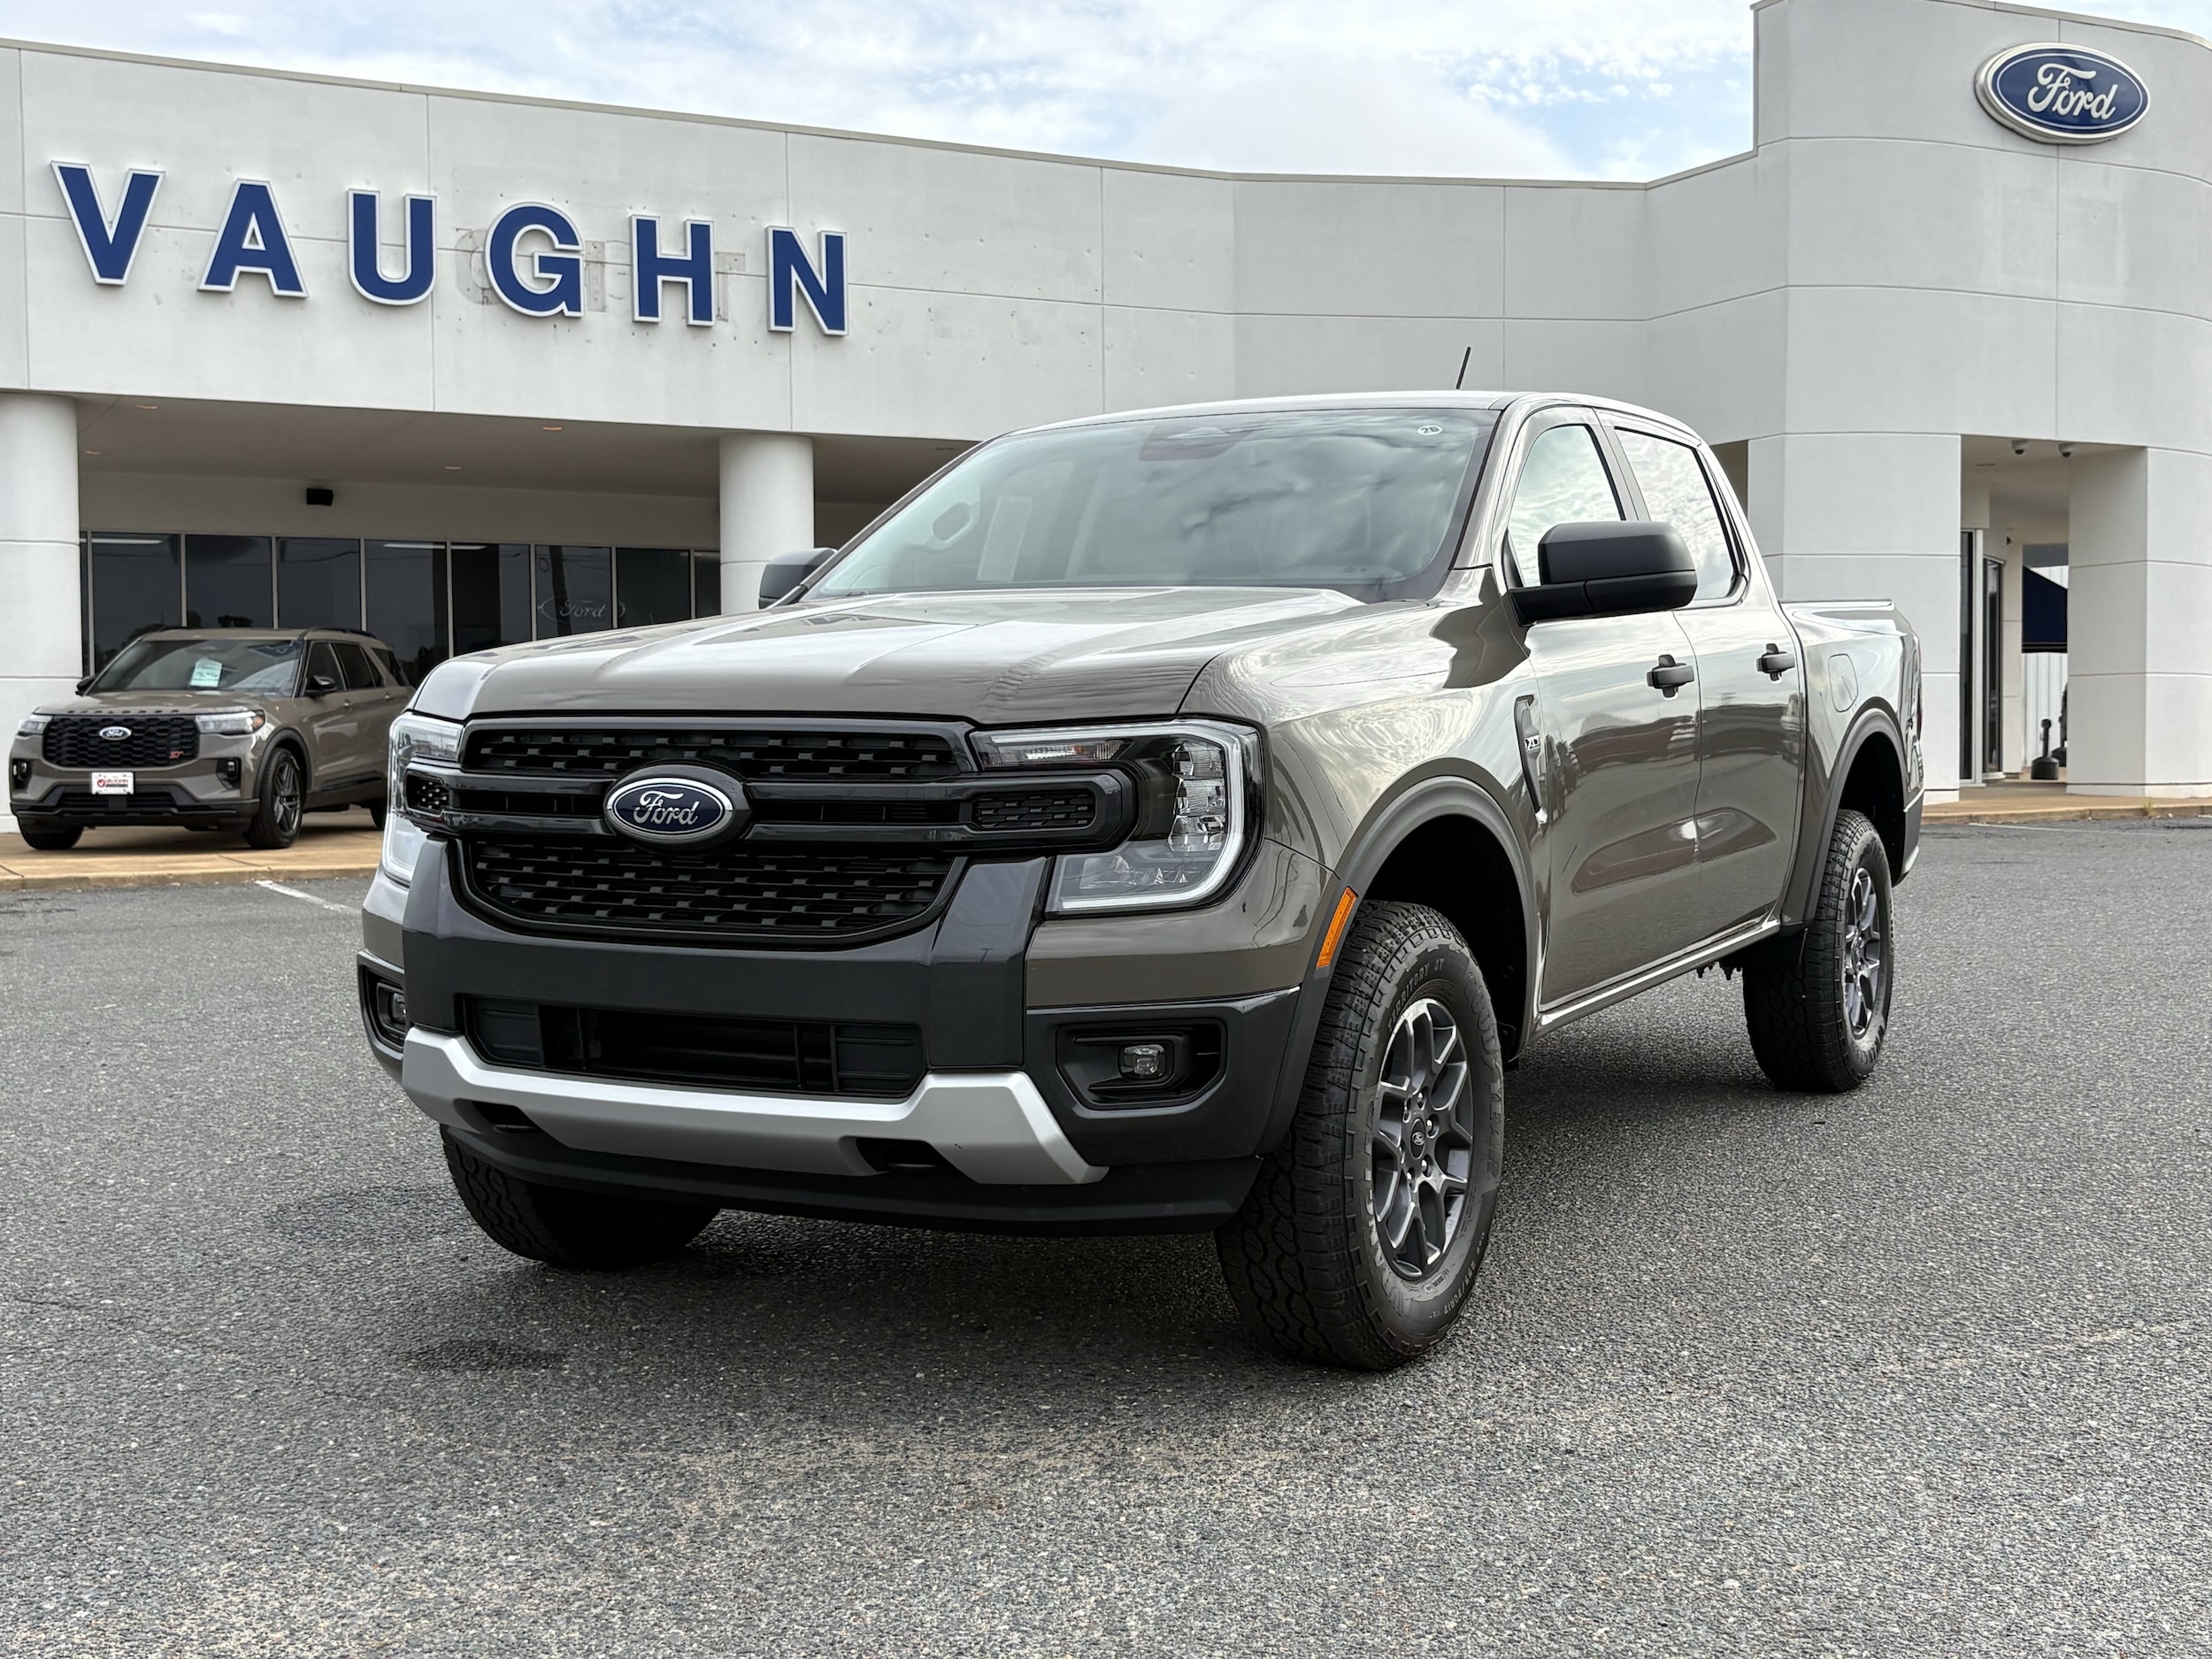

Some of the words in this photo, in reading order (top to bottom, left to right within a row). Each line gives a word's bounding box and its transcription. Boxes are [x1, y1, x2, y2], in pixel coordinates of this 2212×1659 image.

[2027, 63, 2119, 120] Ford
[50, 159, 849, 336] VAUGHN
[559, 599, 608, 618] Ford
[169, 750, 184, 759] ST
[634, 790, 700, 825] Ford
